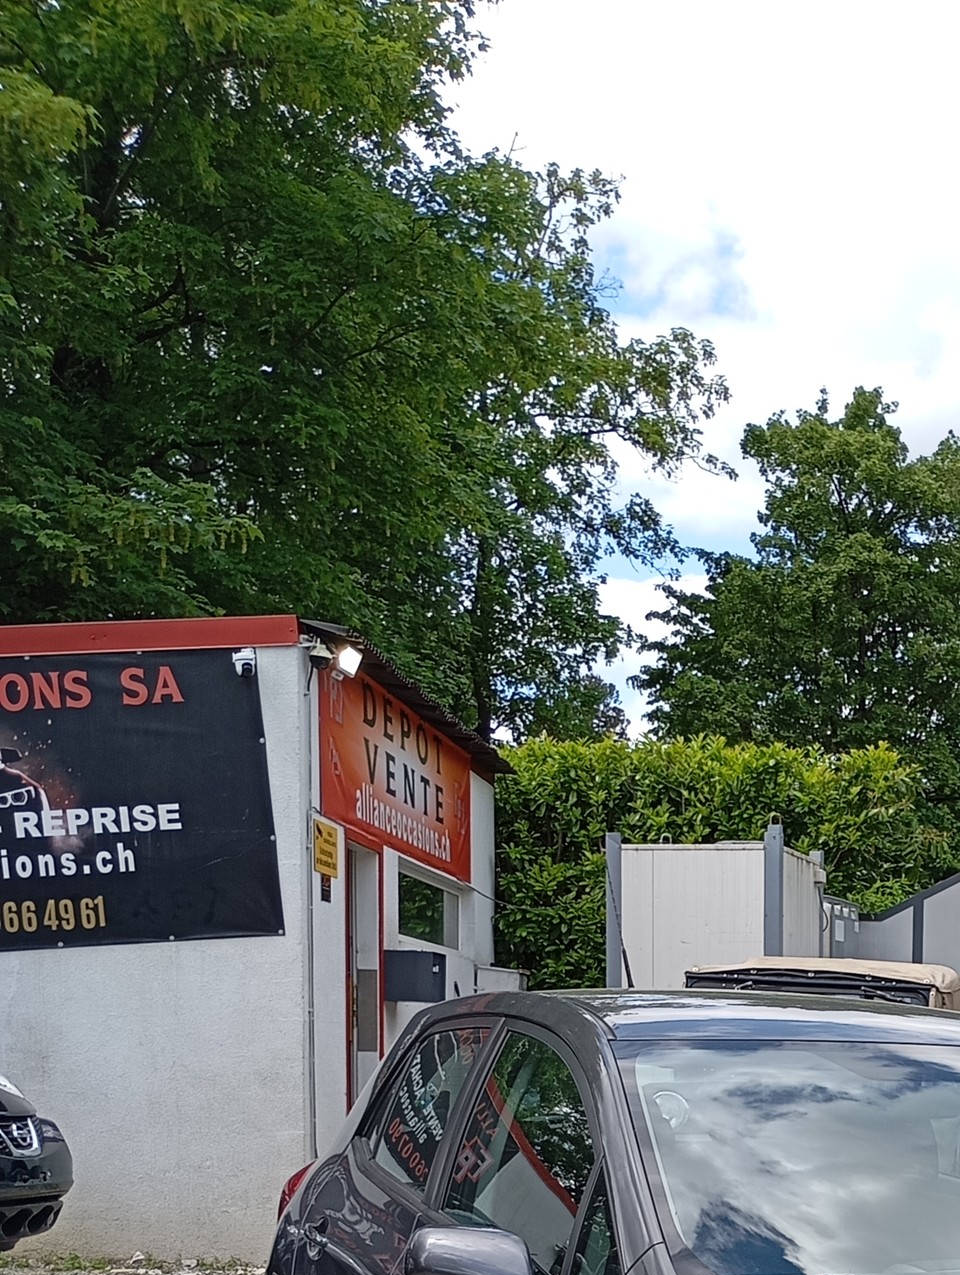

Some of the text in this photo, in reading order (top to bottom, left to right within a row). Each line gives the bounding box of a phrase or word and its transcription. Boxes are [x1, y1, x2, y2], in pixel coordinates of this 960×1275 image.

[0, 666, 184, 712] ONS SA
[363, 736, 444, 825] VENTE
[14, 803, 182, 838] REPRISE
[356, 782, 451, 862] allianceoccasions.ch
[0, 843, 136, 879] ions.ch
[0, 895, 106, 933] 66 49 61
